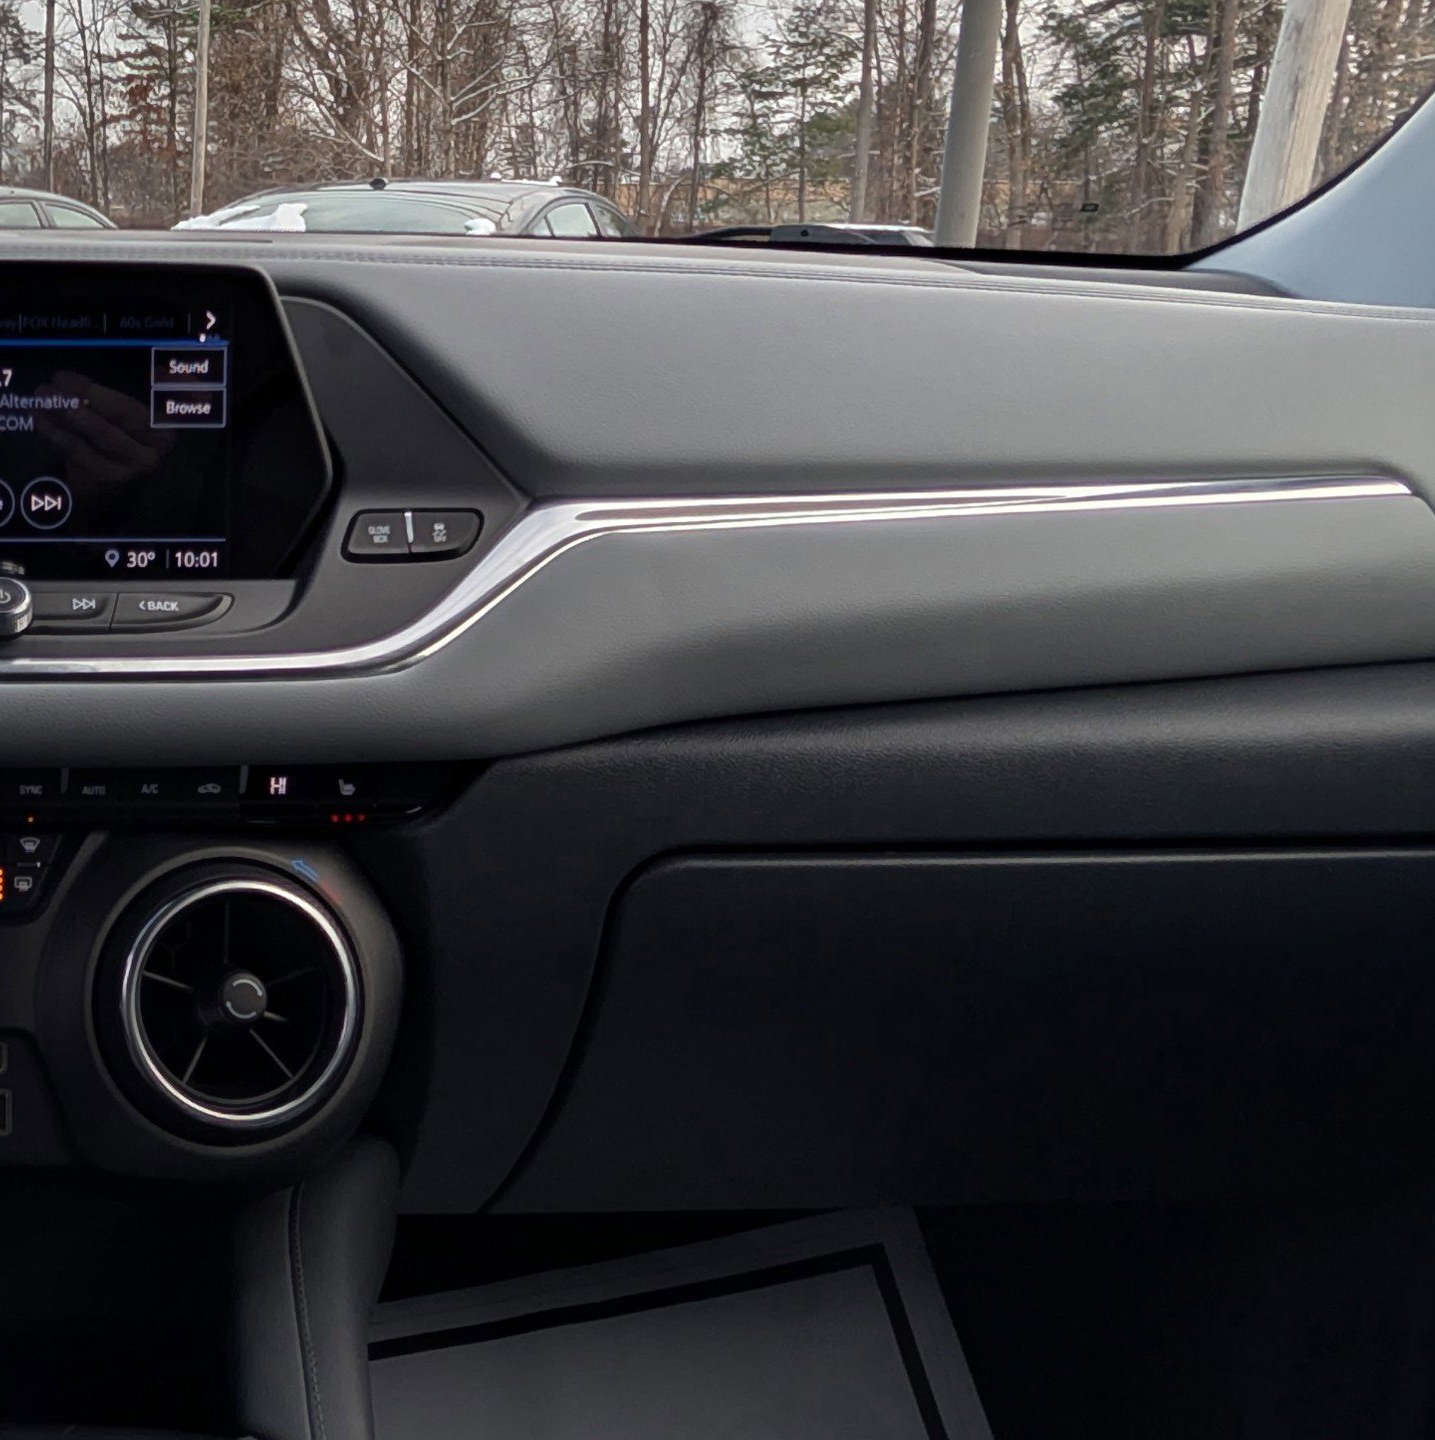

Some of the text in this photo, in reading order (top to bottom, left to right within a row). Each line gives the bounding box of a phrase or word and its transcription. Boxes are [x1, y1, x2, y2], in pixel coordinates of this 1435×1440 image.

[168, 359, 210, 375] Sound
[165, 399, 212, 416] Browse
[125, 551, 156, 569] 30°
[175, 551, 220, 569] 10:01
[146, 599, 180, 613] BACK
[18, 783, 44, 797] SYNC
[81, 784, 107, 797] AUTO
[140, 782, 160, 797] A/C
[269, 776, 288, 796] HI
